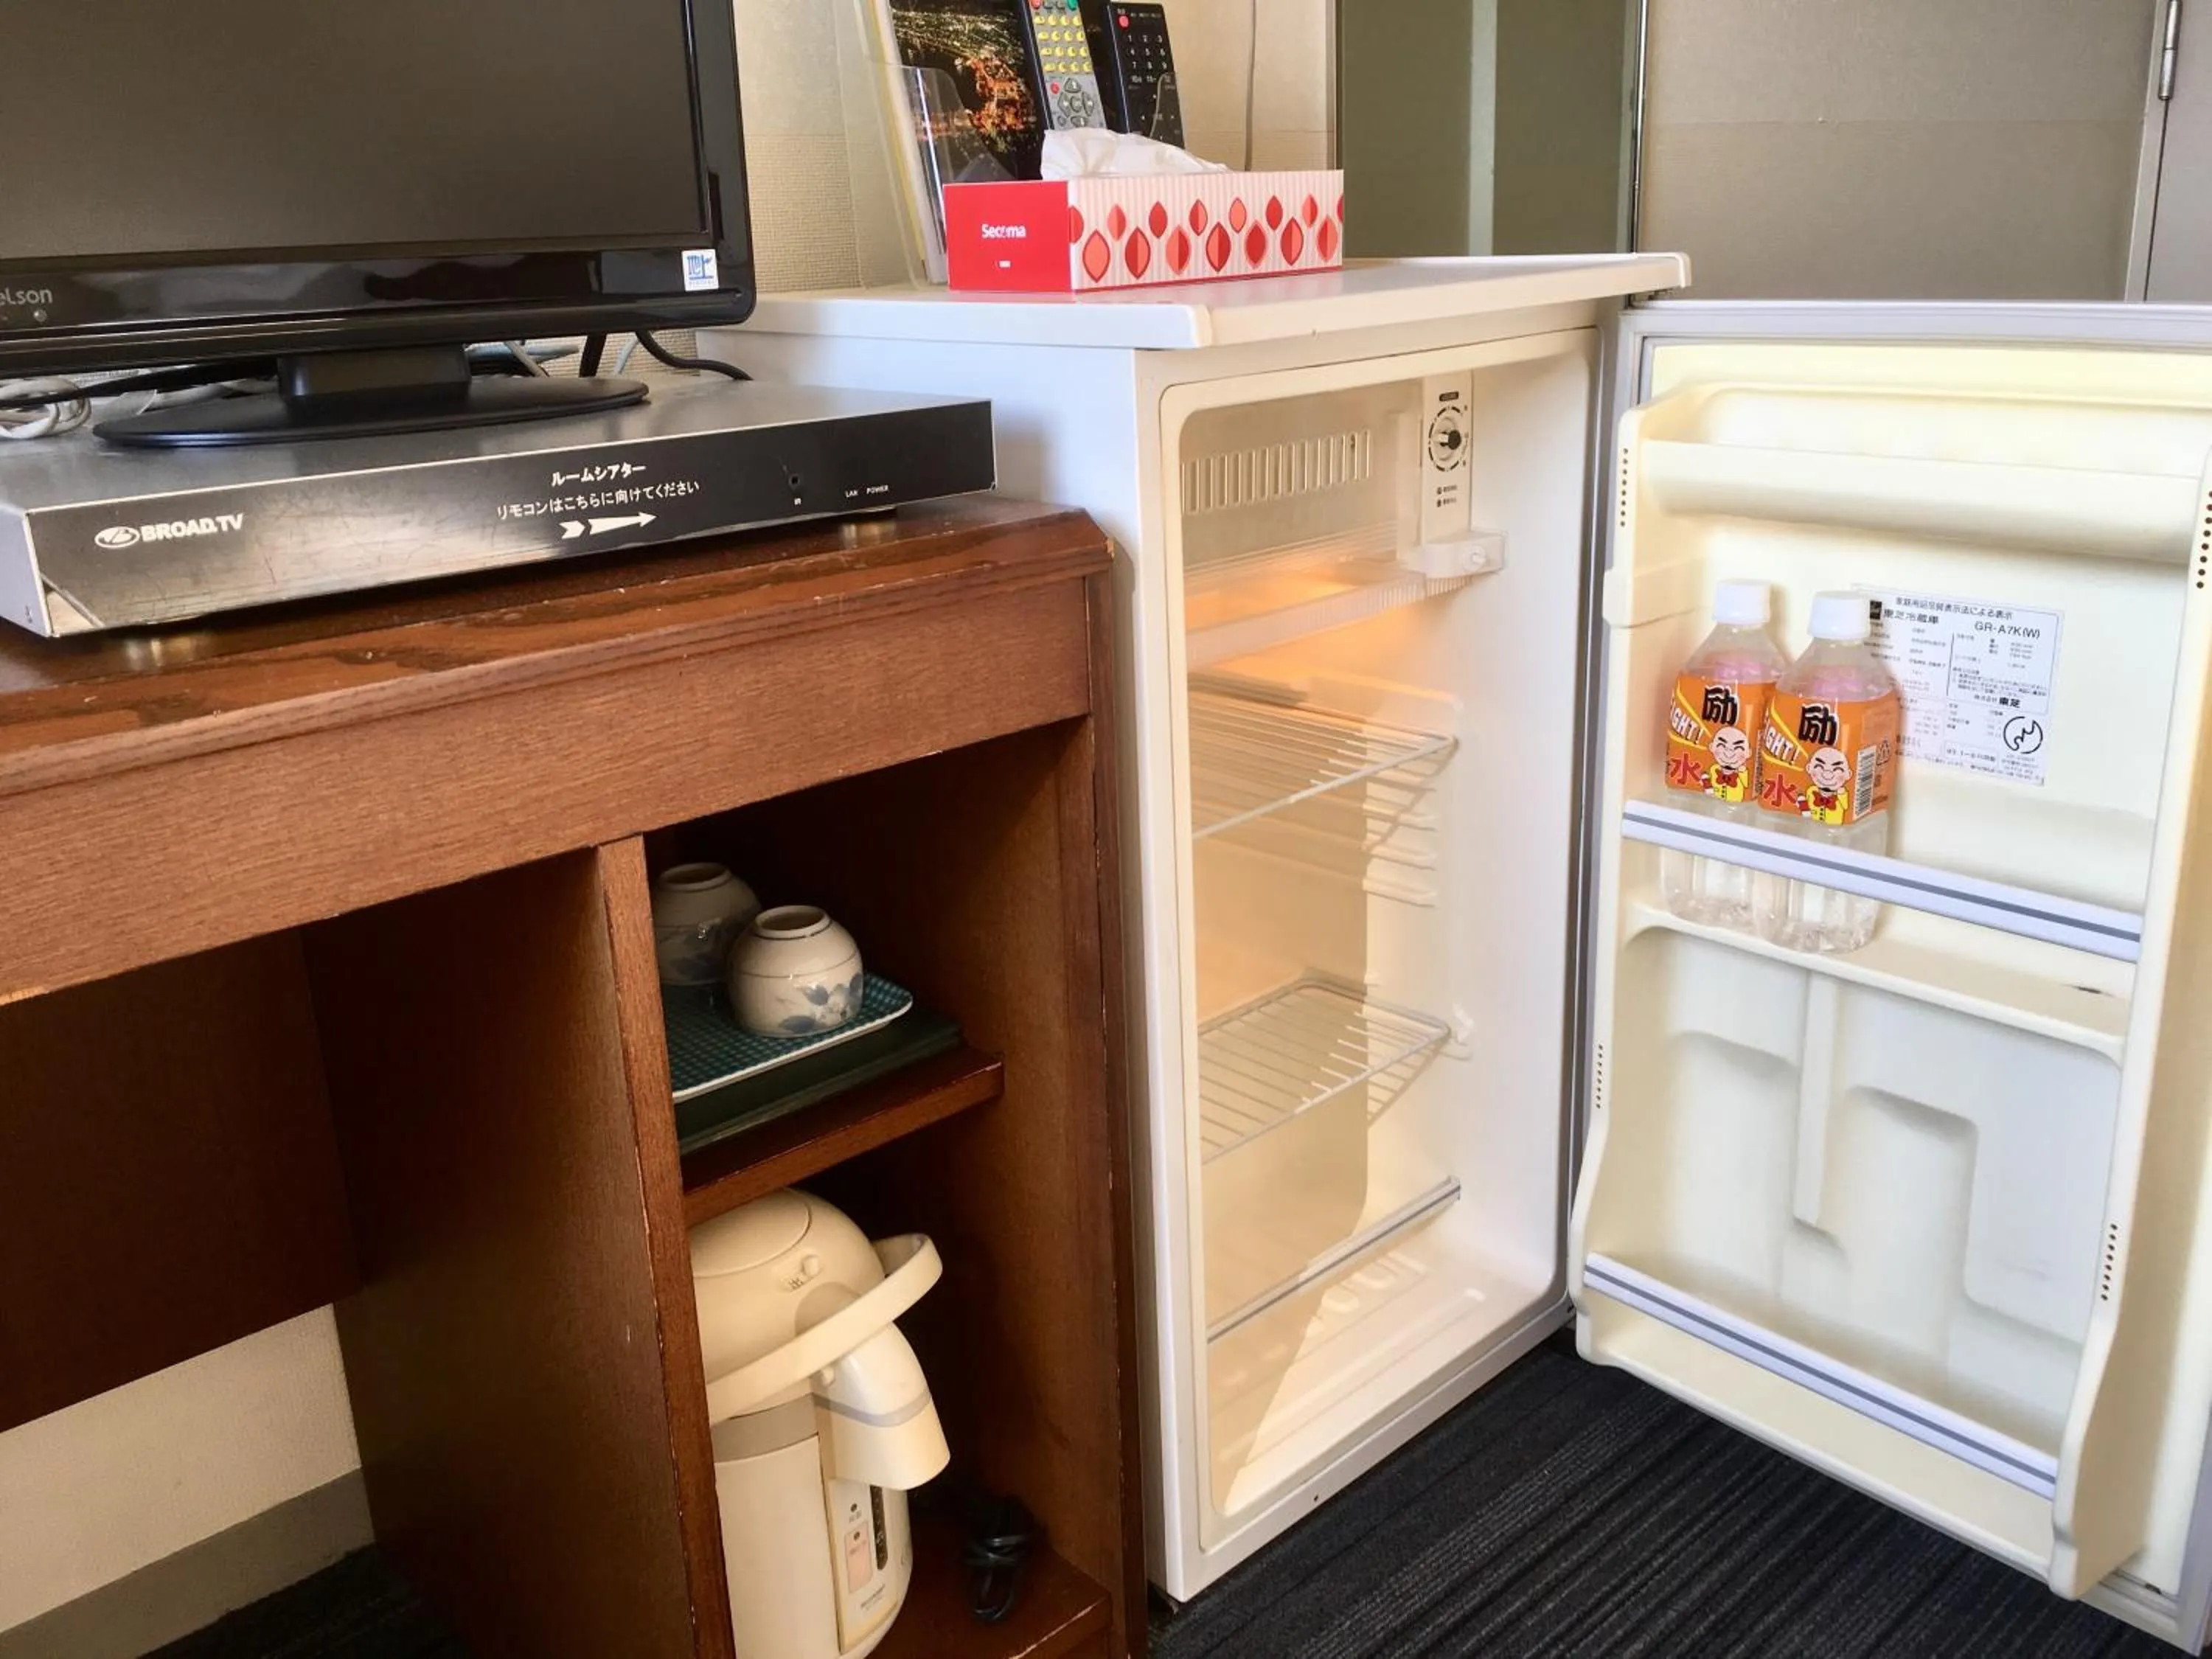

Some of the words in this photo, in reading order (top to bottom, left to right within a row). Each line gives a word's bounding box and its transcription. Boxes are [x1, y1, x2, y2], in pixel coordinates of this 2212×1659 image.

[551, 462, 646, 487] ルームシアター
[845, 490, 858, 498] LAN
[866, 484, 889, 495] POWER
[496, 480, 700, 521] リモコンはこちらに向けてください
[1974, 621, 2041, 639] GR-A7K(W)
[1702, 686, 1739, 726] 励
[1798, 703, 1839, 746] 励
[1670, 753, 1701, 785] 水
[1763, 773, 1797, 807] 水
